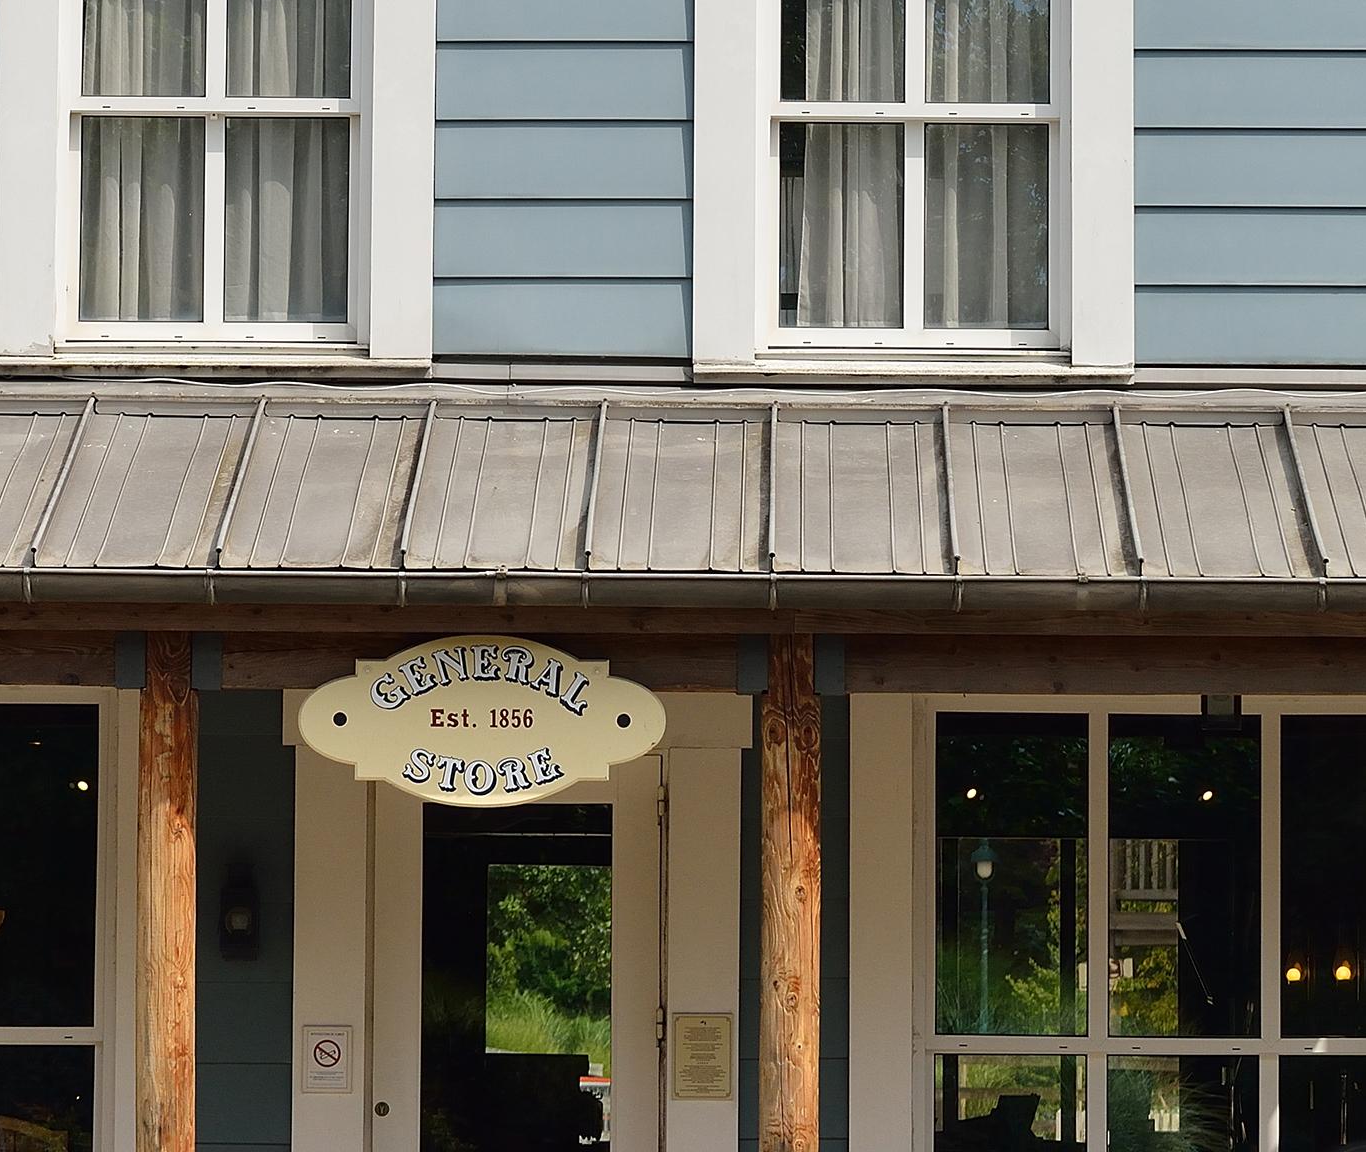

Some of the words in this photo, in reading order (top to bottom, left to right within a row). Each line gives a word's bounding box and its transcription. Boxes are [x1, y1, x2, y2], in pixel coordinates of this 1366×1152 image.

[370, 644, 590, 717] GENERAL
[430, 708, 477, 728] Est.
[489, 708, 534, 729] 1856
[402, 747, 565, 796] STORE
